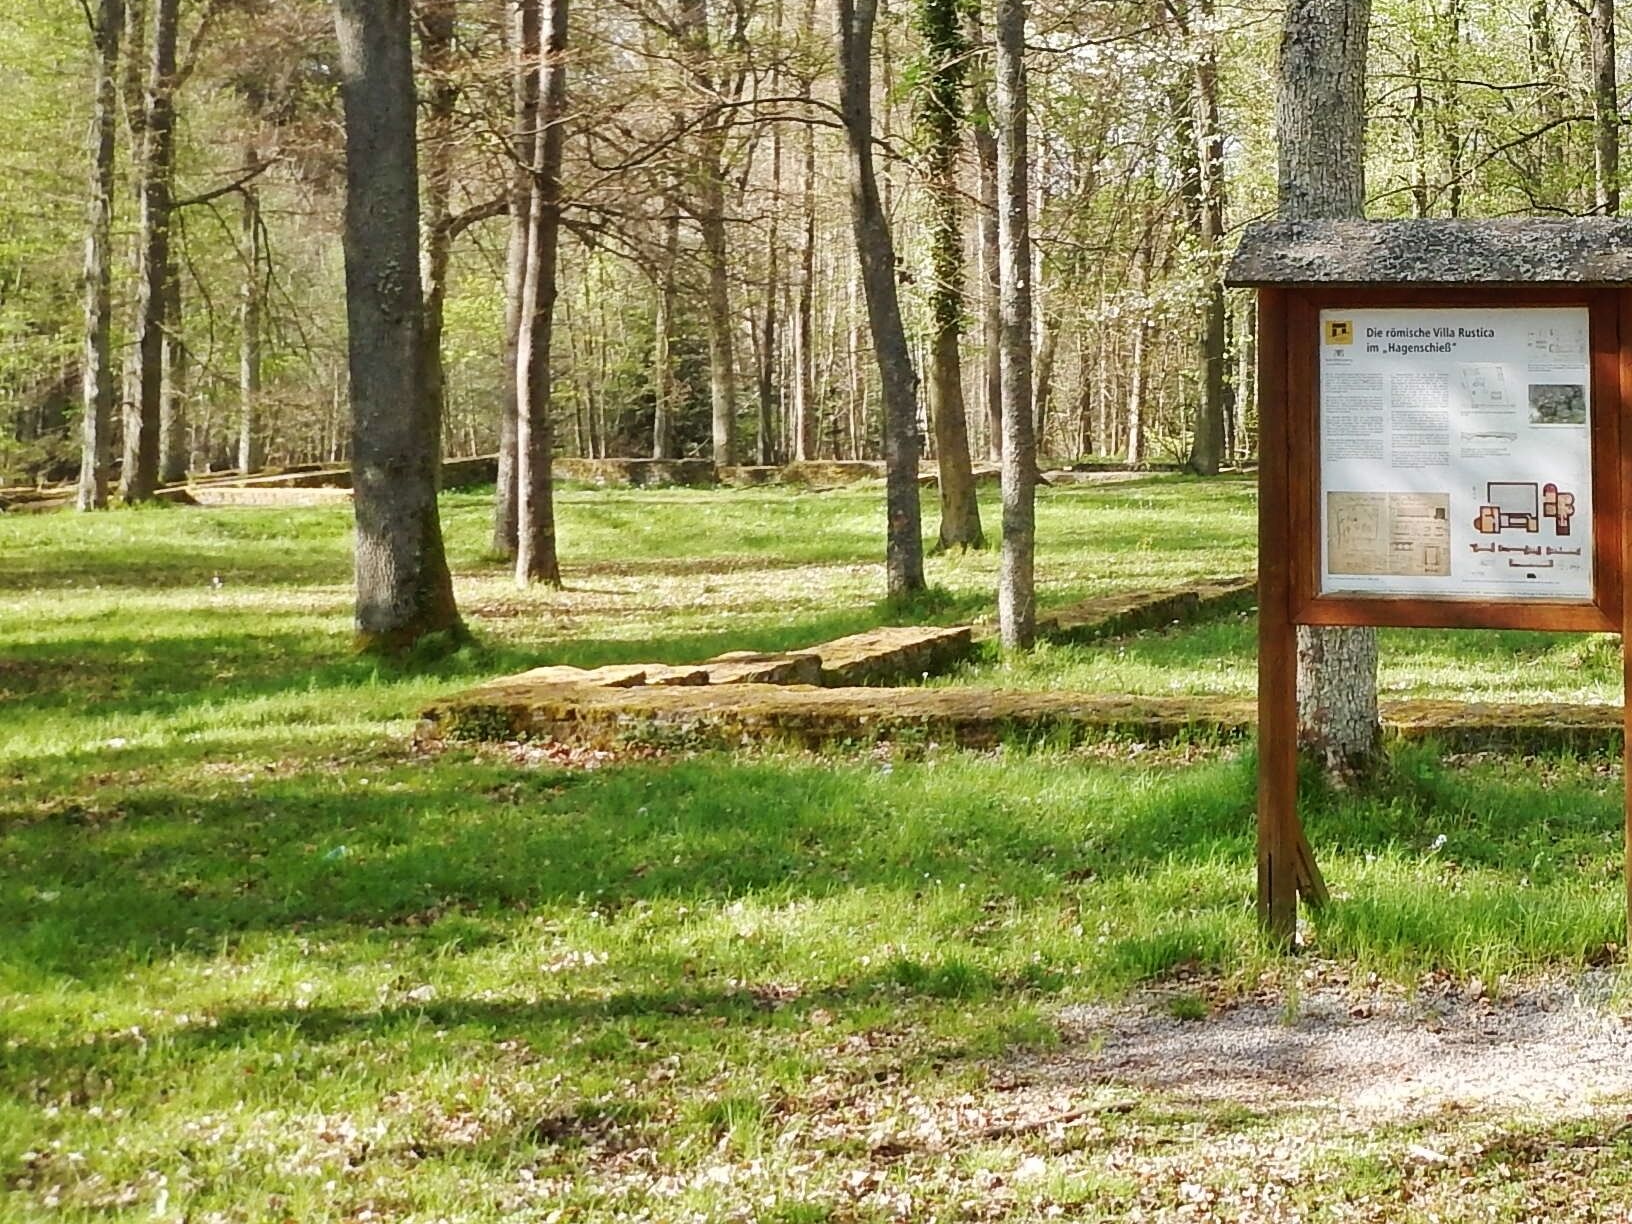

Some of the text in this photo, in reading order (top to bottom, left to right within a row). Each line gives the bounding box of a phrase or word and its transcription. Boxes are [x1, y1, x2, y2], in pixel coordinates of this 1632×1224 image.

[1366, 327, 1495, 338] Die römische Villa Rustica
[1366, 342, 1379, 353] im
